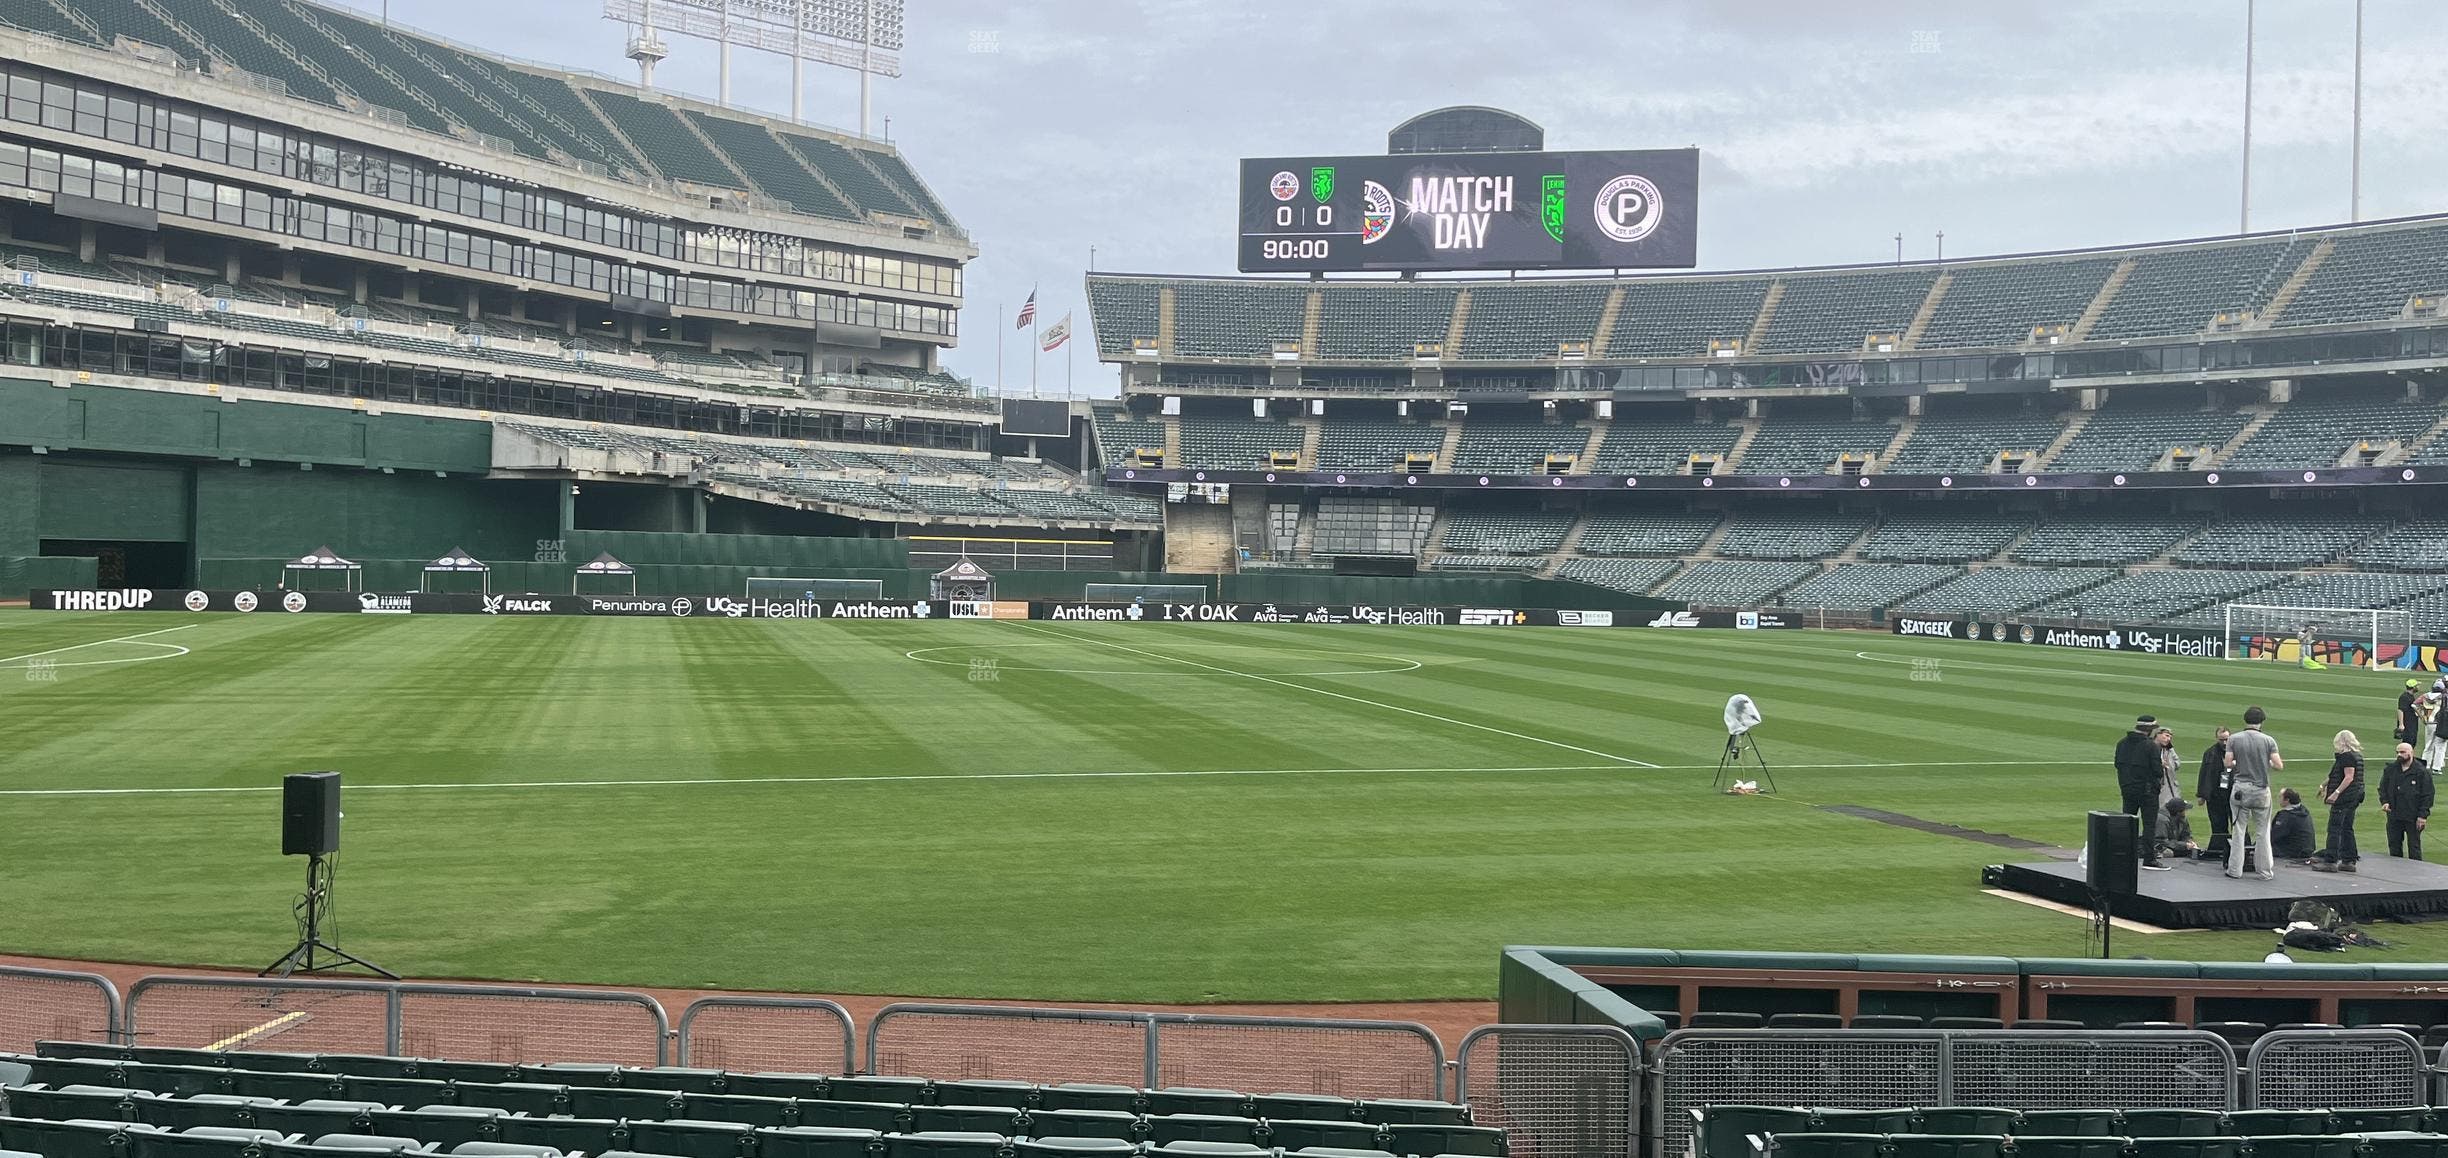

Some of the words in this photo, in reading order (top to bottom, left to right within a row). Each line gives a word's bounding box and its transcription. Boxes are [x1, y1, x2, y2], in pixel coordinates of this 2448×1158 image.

[1369, 186, 1392, 213] ROOTS
[1411, 176, 1513, 213] MATCH
[1601, 181, 1629, 206] DOUGLAS
[1630, 181, 1656, 205] PARKING
[1276, 206, 1292, 226] 0
[1316, 205, 1332, 226] 0
[1617, 193, 1642, 224] P
[1435, 213, 1490, 249] DAY
[1263, 239, 1328, 259] 90:00
[52, 588, 153, 610] THREDUP
[505, 600, 552, 611] FALCK
[592, 599, 667, 612] Penumbra
[707, 598, 749, 618] UCSF
[752, 598, 821, 618] Health
[832, 603, 909, 618] Anthem
[1052, 605, 1123, 620] Anthem
[1163, 604, 1173, 620] I
[1199, 604, 1239, 621] OAK
[1253, 611, 1278, 623] Ava
[1304, 612, 1328, 623] Ava
[1352, 606, 1386, 624] UCSF
[1388, 607, 1444, 625] Health
[1900, 618, 1953, 638] SEATGEEK
[2045, 629, 2103, 648] Anthem
[2128, 631, 2163, 653] UCSF
[2165, 633, 2223, 657] Health
